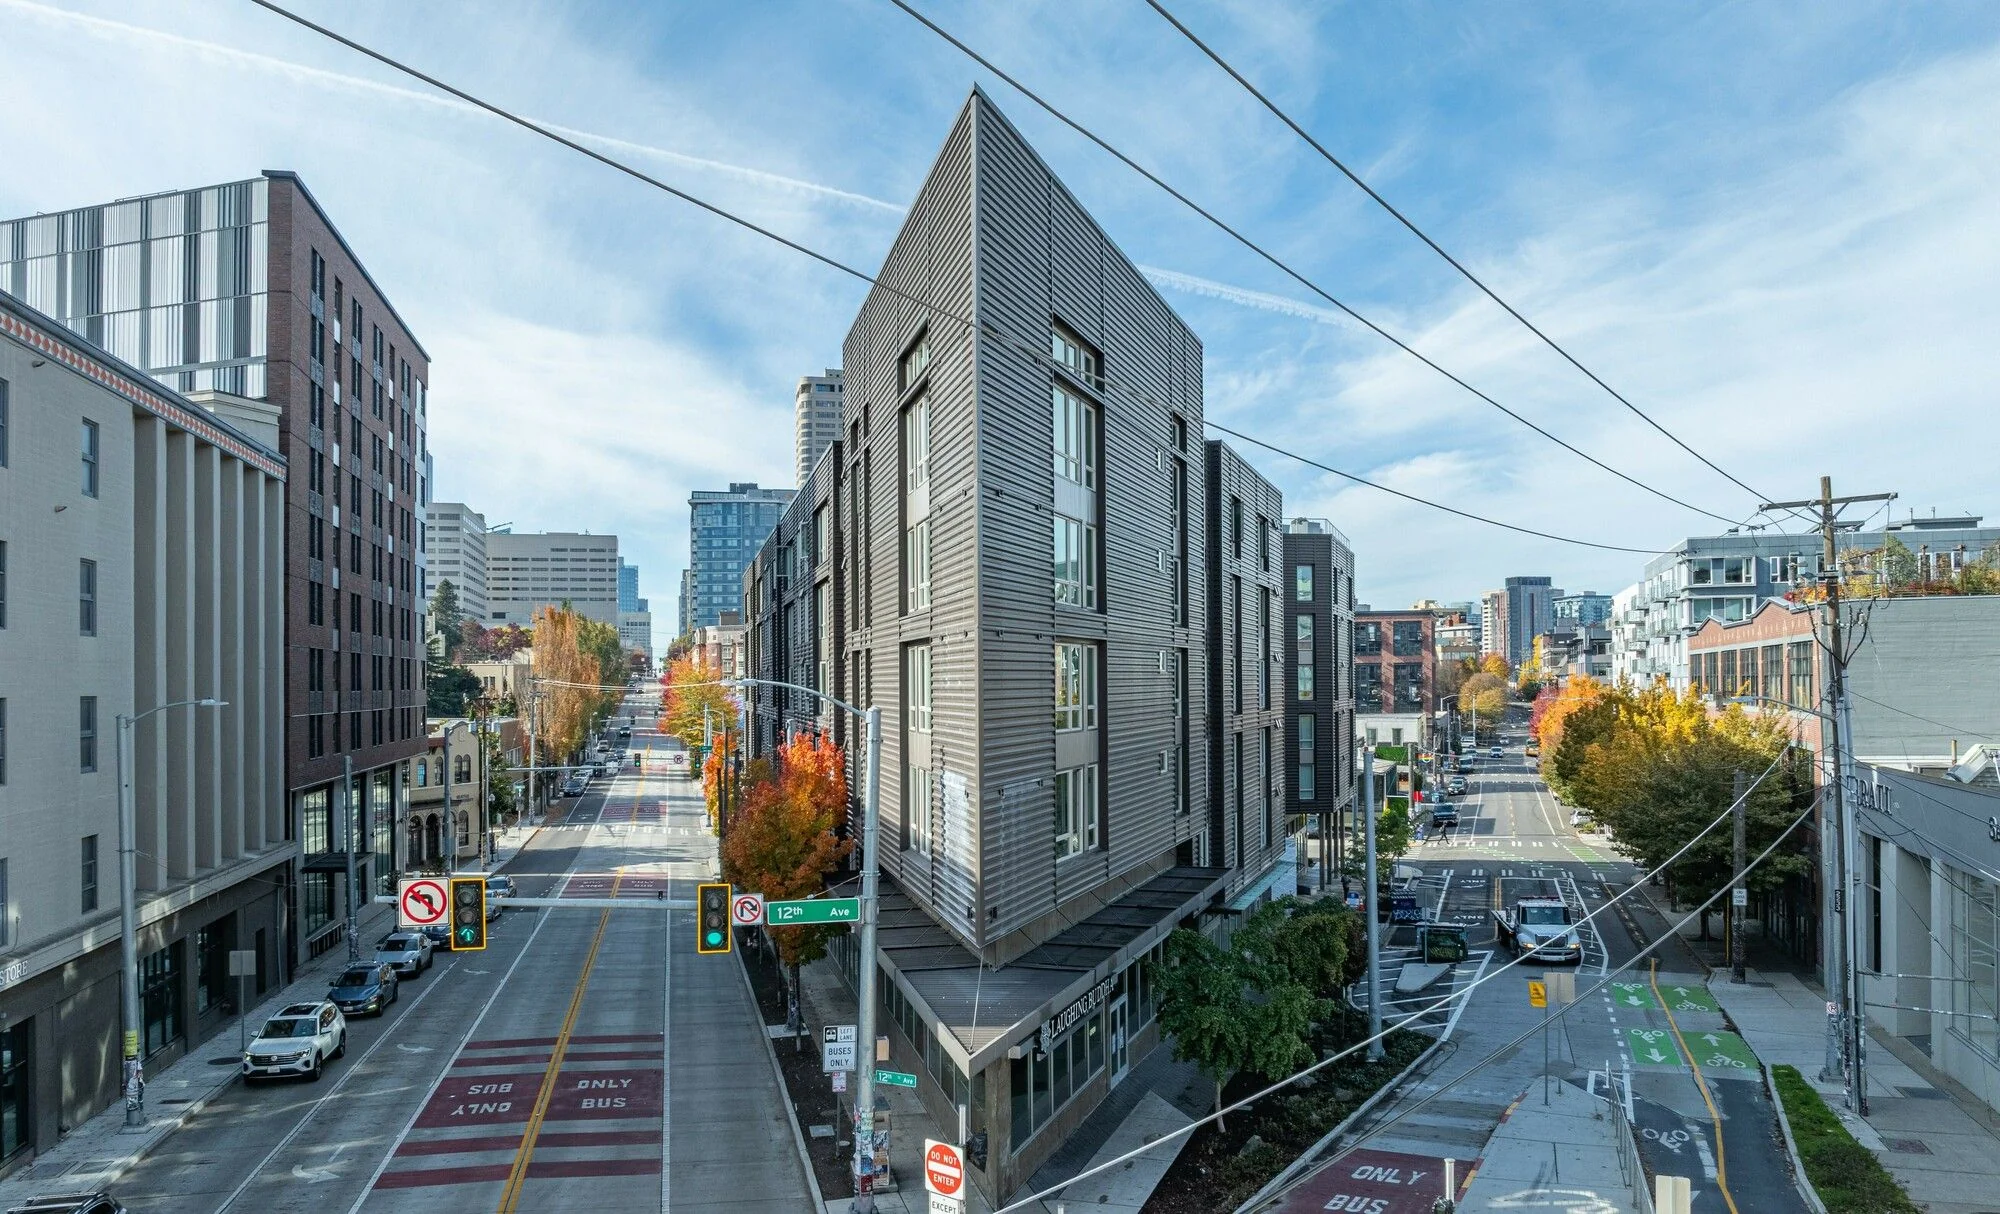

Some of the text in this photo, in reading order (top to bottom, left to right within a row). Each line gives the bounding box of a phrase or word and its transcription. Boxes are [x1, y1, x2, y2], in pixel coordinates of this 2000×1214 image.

[777, 906, 850, 919] 12th Ave
[0, 960, 28, 986] STORE
[1051, 978, 1114, 1039] LAUGHING BUDDHA
[828, 1047, 852, 1056] BUSES
[830, 1059, 850, 1067] ONLY
[577, 1078, 632, 1089] ONLY
[902, 1076, 914, 1085] Ave
[467, 1083, 513, 1095] BUS
[450, 1101, 512, 1116] ONLY
[581, 1097, 626, 1109] BUS
[931, 1151, 957, 1165] DO NOT
[933, 1173, 955, 1187] ENTER
[1351, 1165, 1428, 1186] ONLY
[931, 1200, 957, 1214] EXCEPT
[1323, 1194, 1390, 1214] BUS
